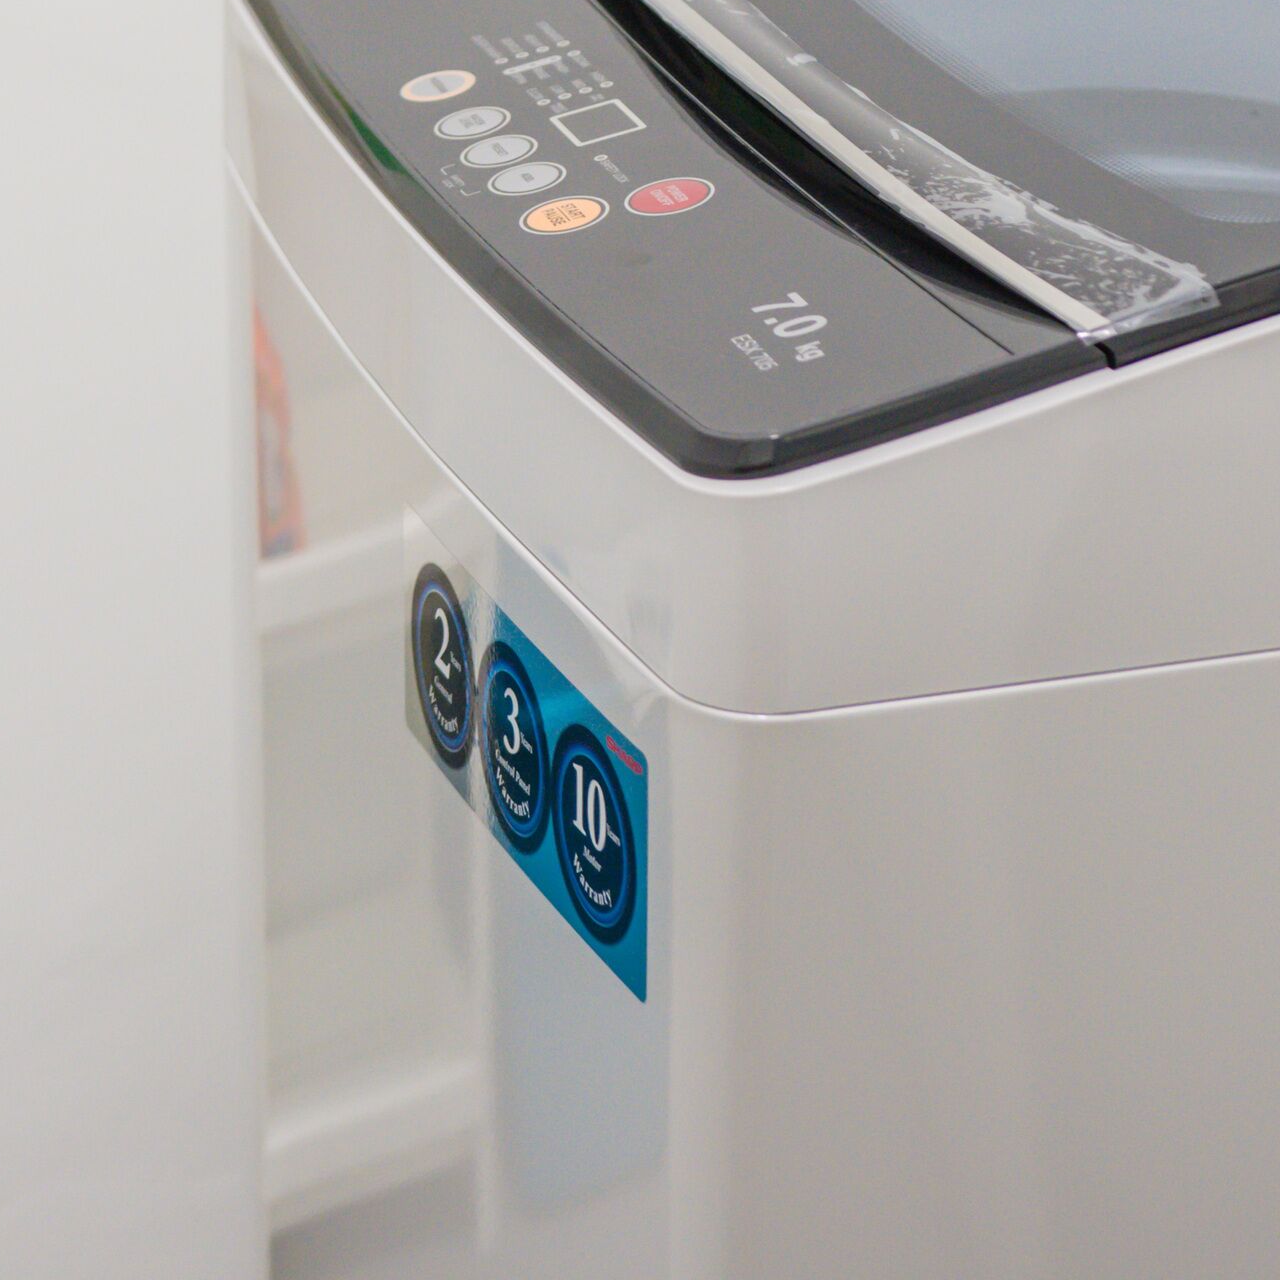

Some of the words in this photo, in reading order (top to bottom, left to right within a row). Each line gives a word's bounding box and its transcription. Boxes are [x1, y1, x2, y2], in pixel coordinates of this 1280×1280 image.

[544, 207, 568, 227] PAUSE
[561, 203, 587, 220] START
[751, 292, 828, 338] 7.0
[795, 341, 826, 362] kg
[434, 608, 451, 680] 2
[429, 683, 459, 734] Warranty
[504, 687, 521, 755] 3
[495, 766, 531, 819] Warranty
[515, 770, 531, 797] Panel
[572, 762, 607, 852] 10
[573, 852, 613, 908] Warranty
